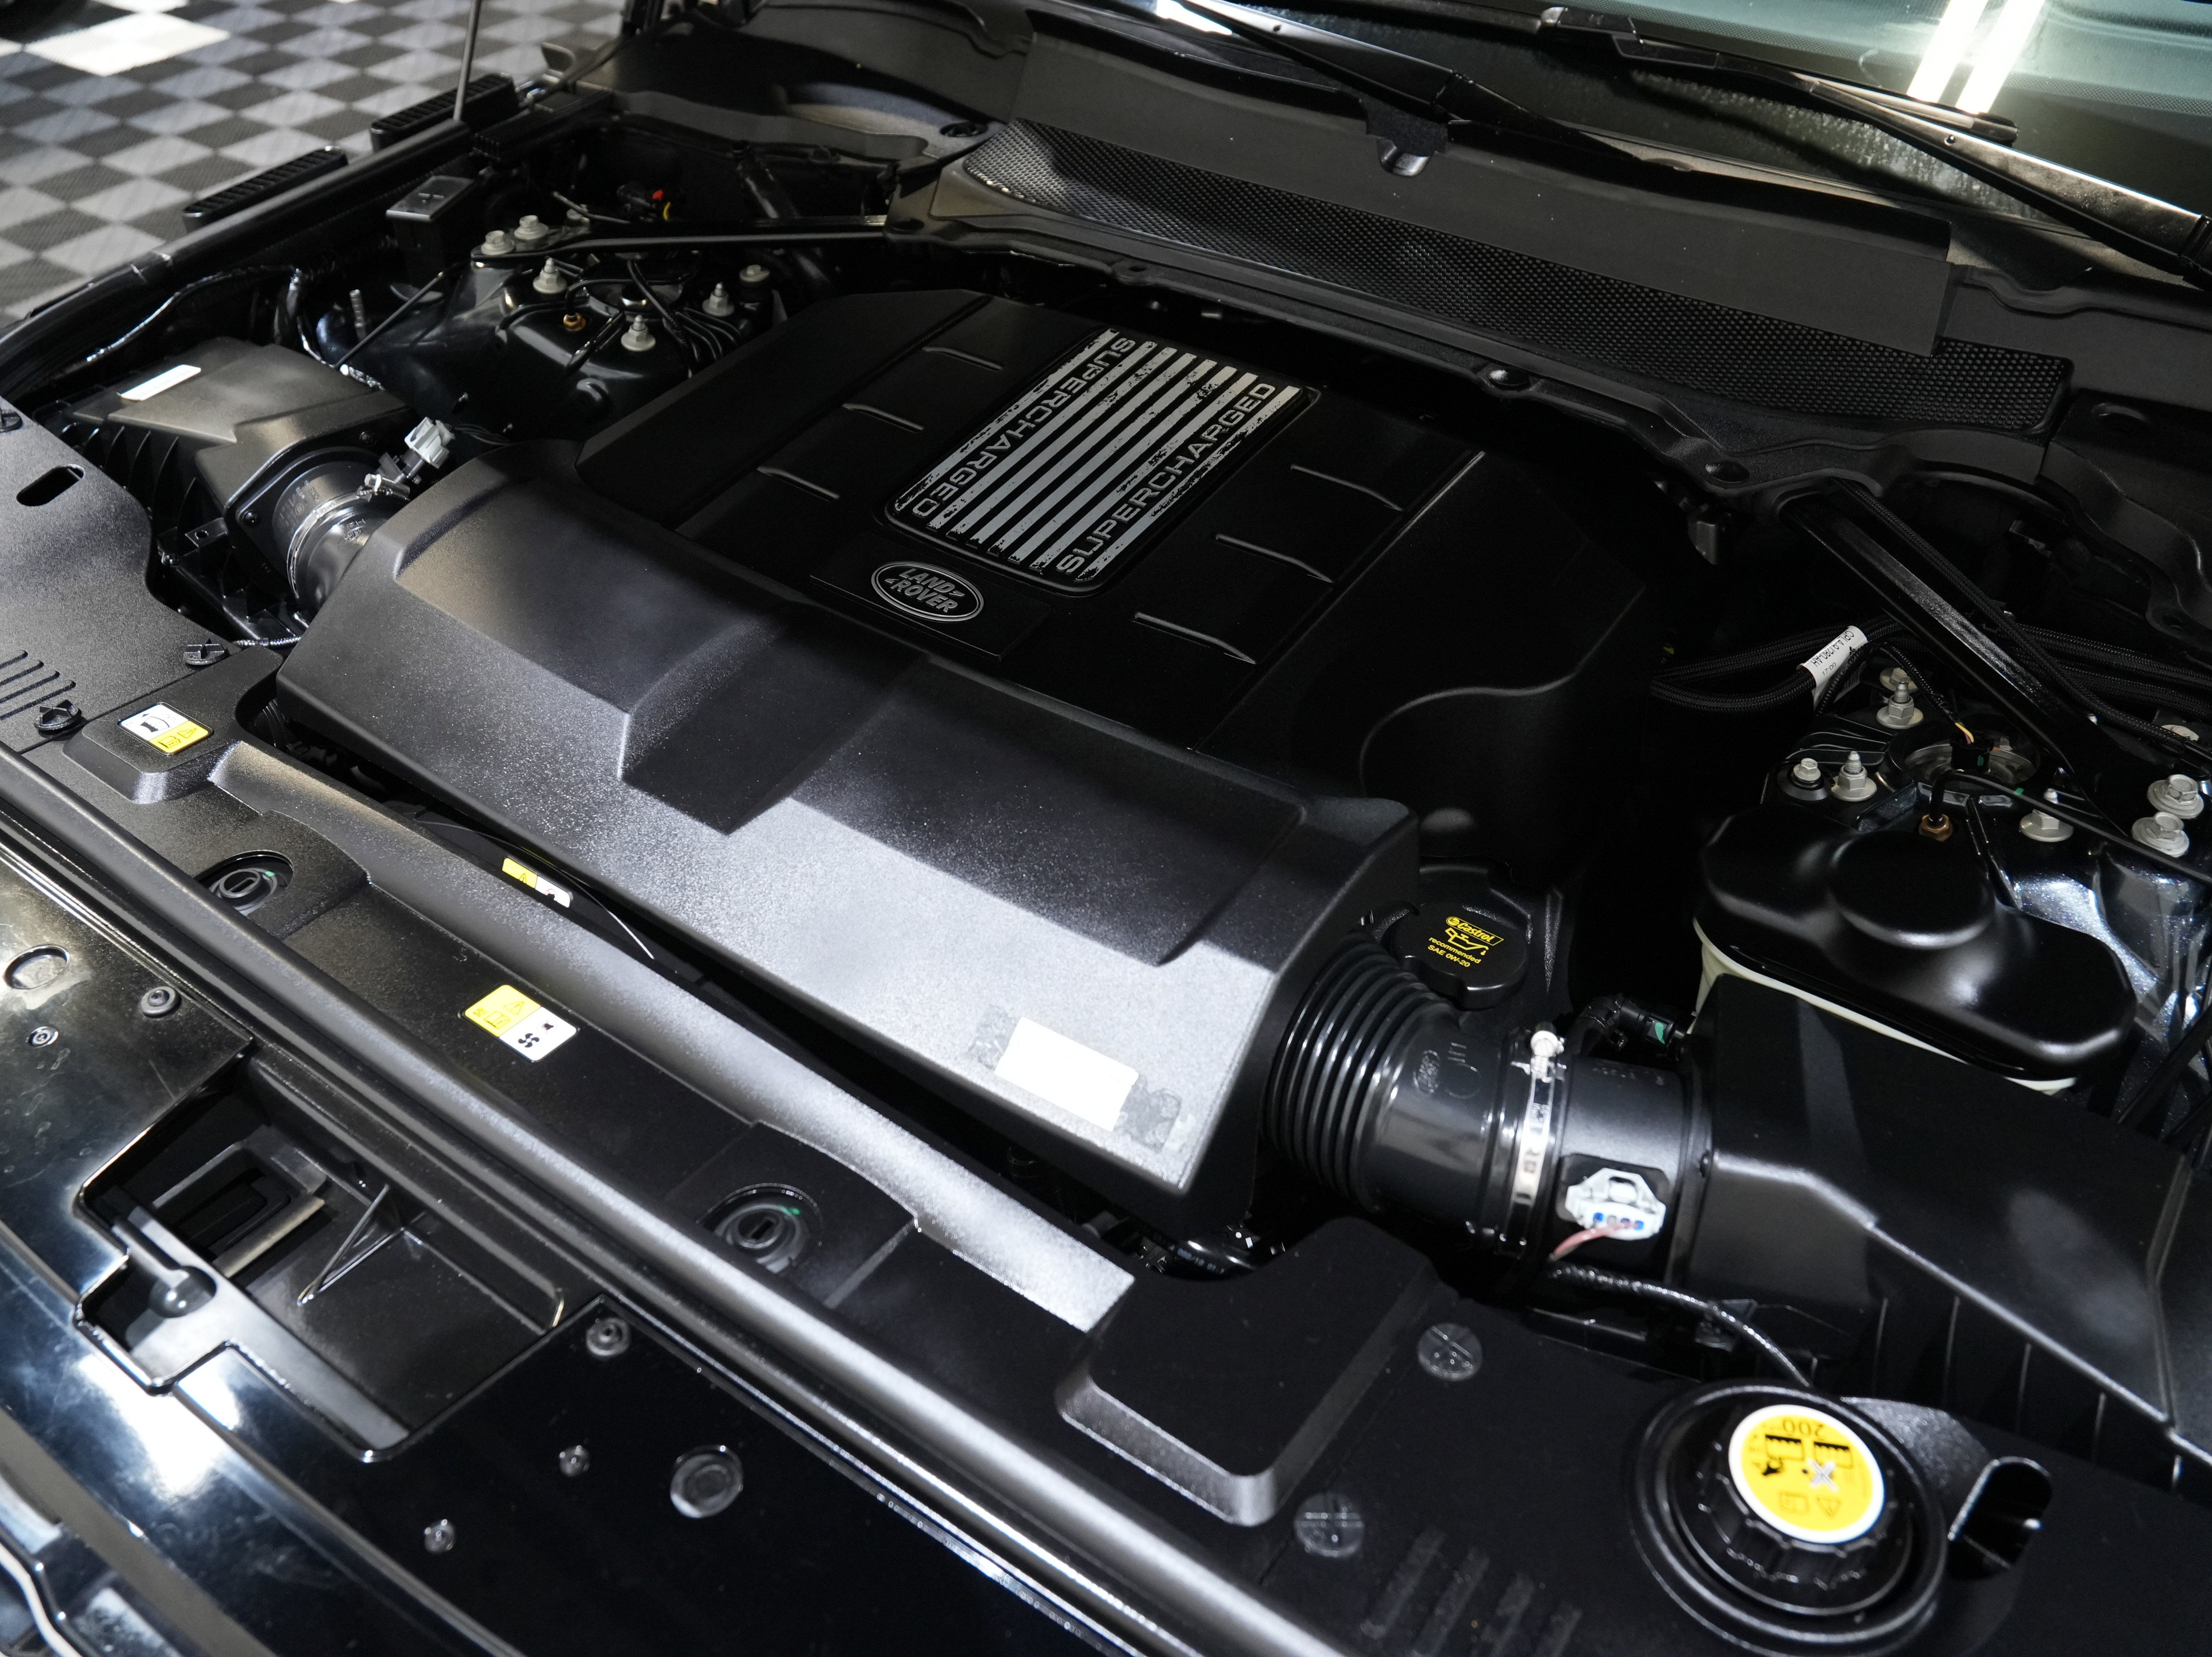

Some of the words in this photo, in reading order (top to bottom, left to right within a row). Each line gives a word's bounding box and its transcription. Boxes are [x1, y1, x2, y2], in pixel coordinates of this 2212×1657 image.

[912, 337, 1137, 518] SUPERCHARGED
[1055, 383, 1277, 573] SUPERCHARGED
[899, 568, 955, 593] LAND
[890, 580, 958, 613] ROVER
[1457, 922, 1495, 943] Castrol
[1428, 944, 1445, 956] SAE
[1445, 953, 1471, 968] 0W-20
[1429, 937, 1481, 964] recommended
[1783, 1419, 1824, 1440] 200
